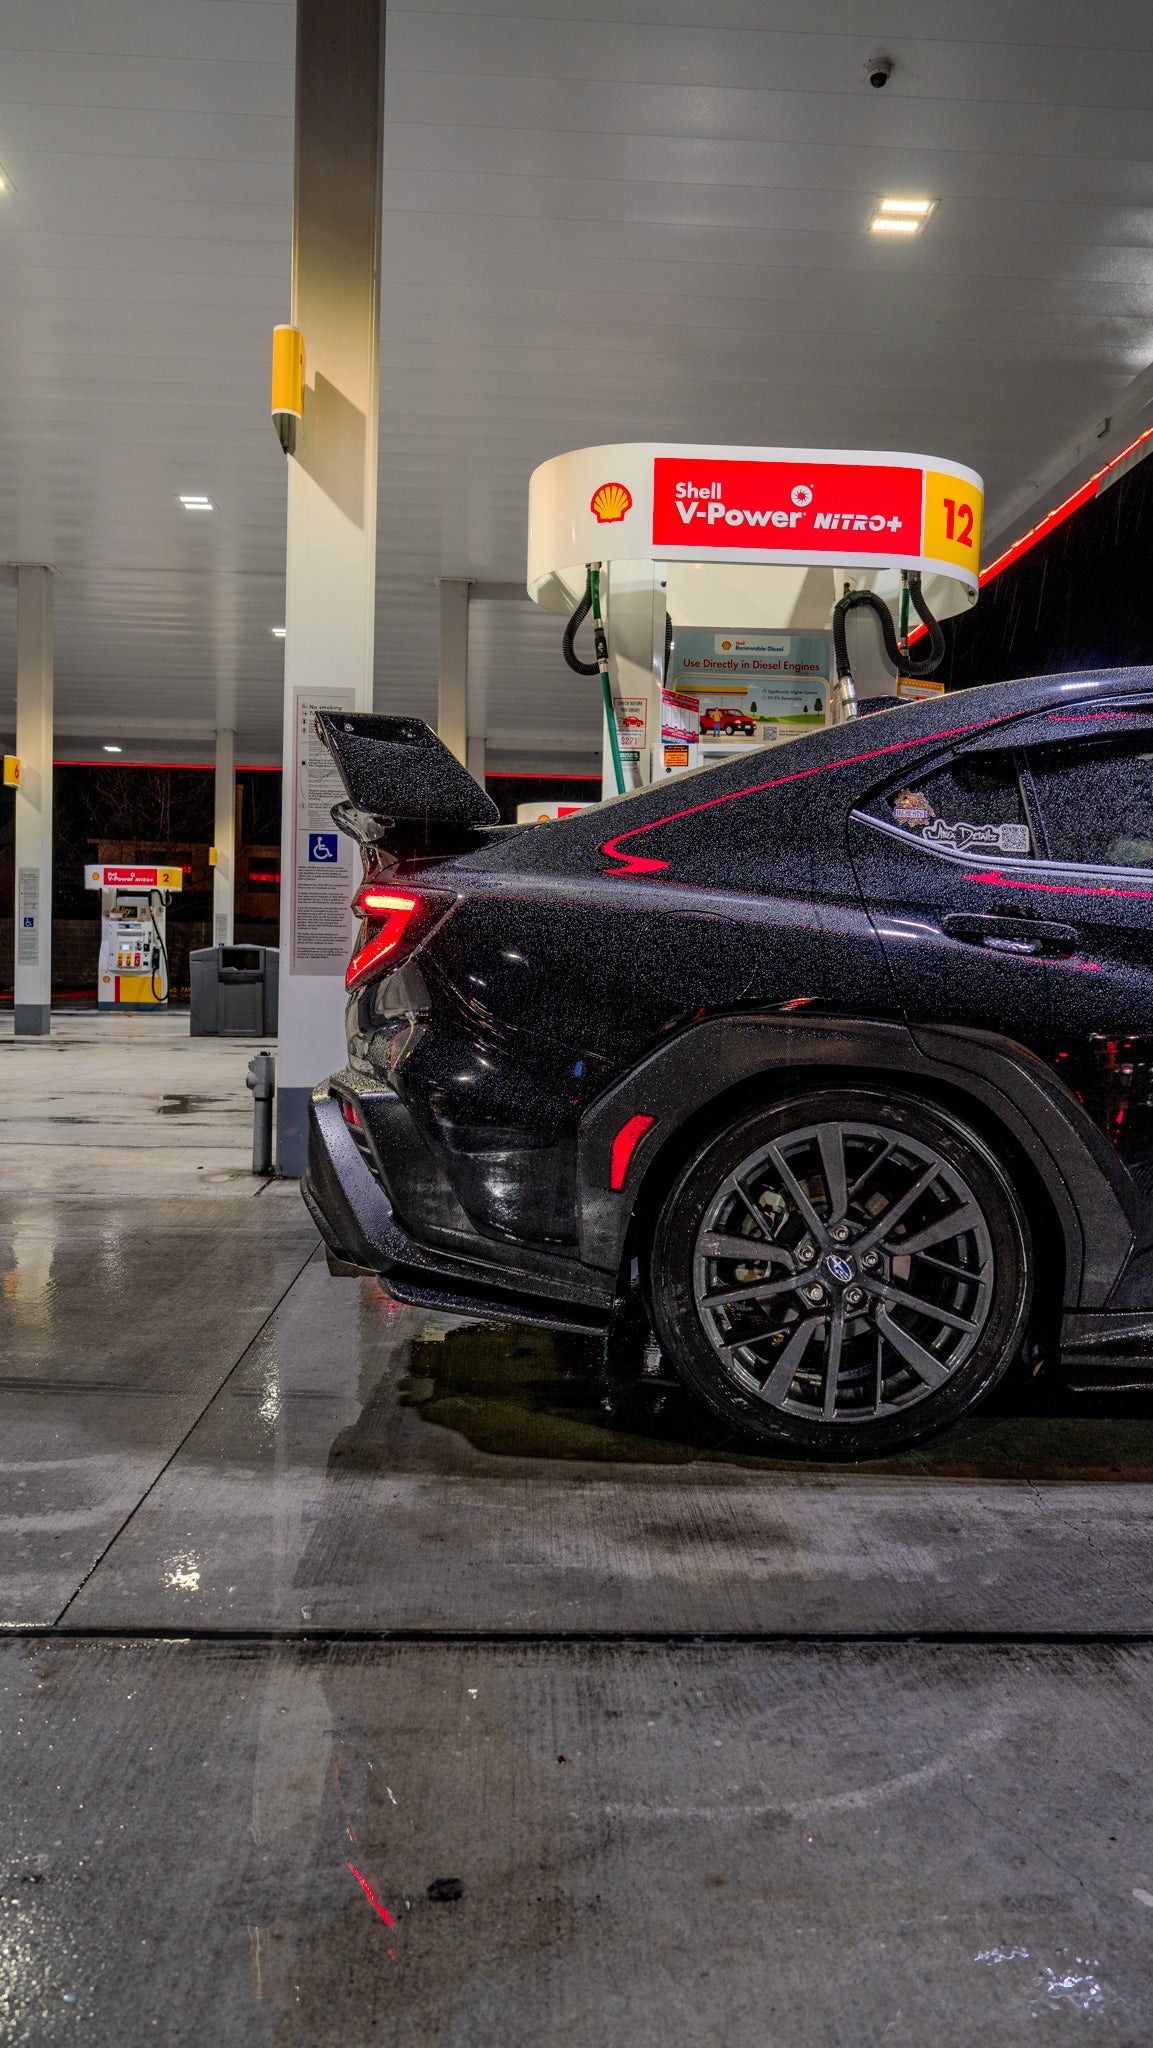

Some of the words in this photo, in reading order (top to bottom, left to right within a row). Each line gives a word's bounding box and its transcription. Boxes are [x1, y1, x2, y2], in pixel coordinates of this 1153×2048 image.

[675, 482, 722, 500] Shell
[675, 500, 803, 528] V-Power
[943, 498, 974, 549] 12
[683, 659, 701, 668] Use
[703, 659, 739, 671] Directly
[741, 659, 750, 669] in
[752, 660, 781, 670] Diesel
[783, 661, 820, 673] Engines
[14, 764, 20, 779] 6
[163, 873, 169, 883] 2
